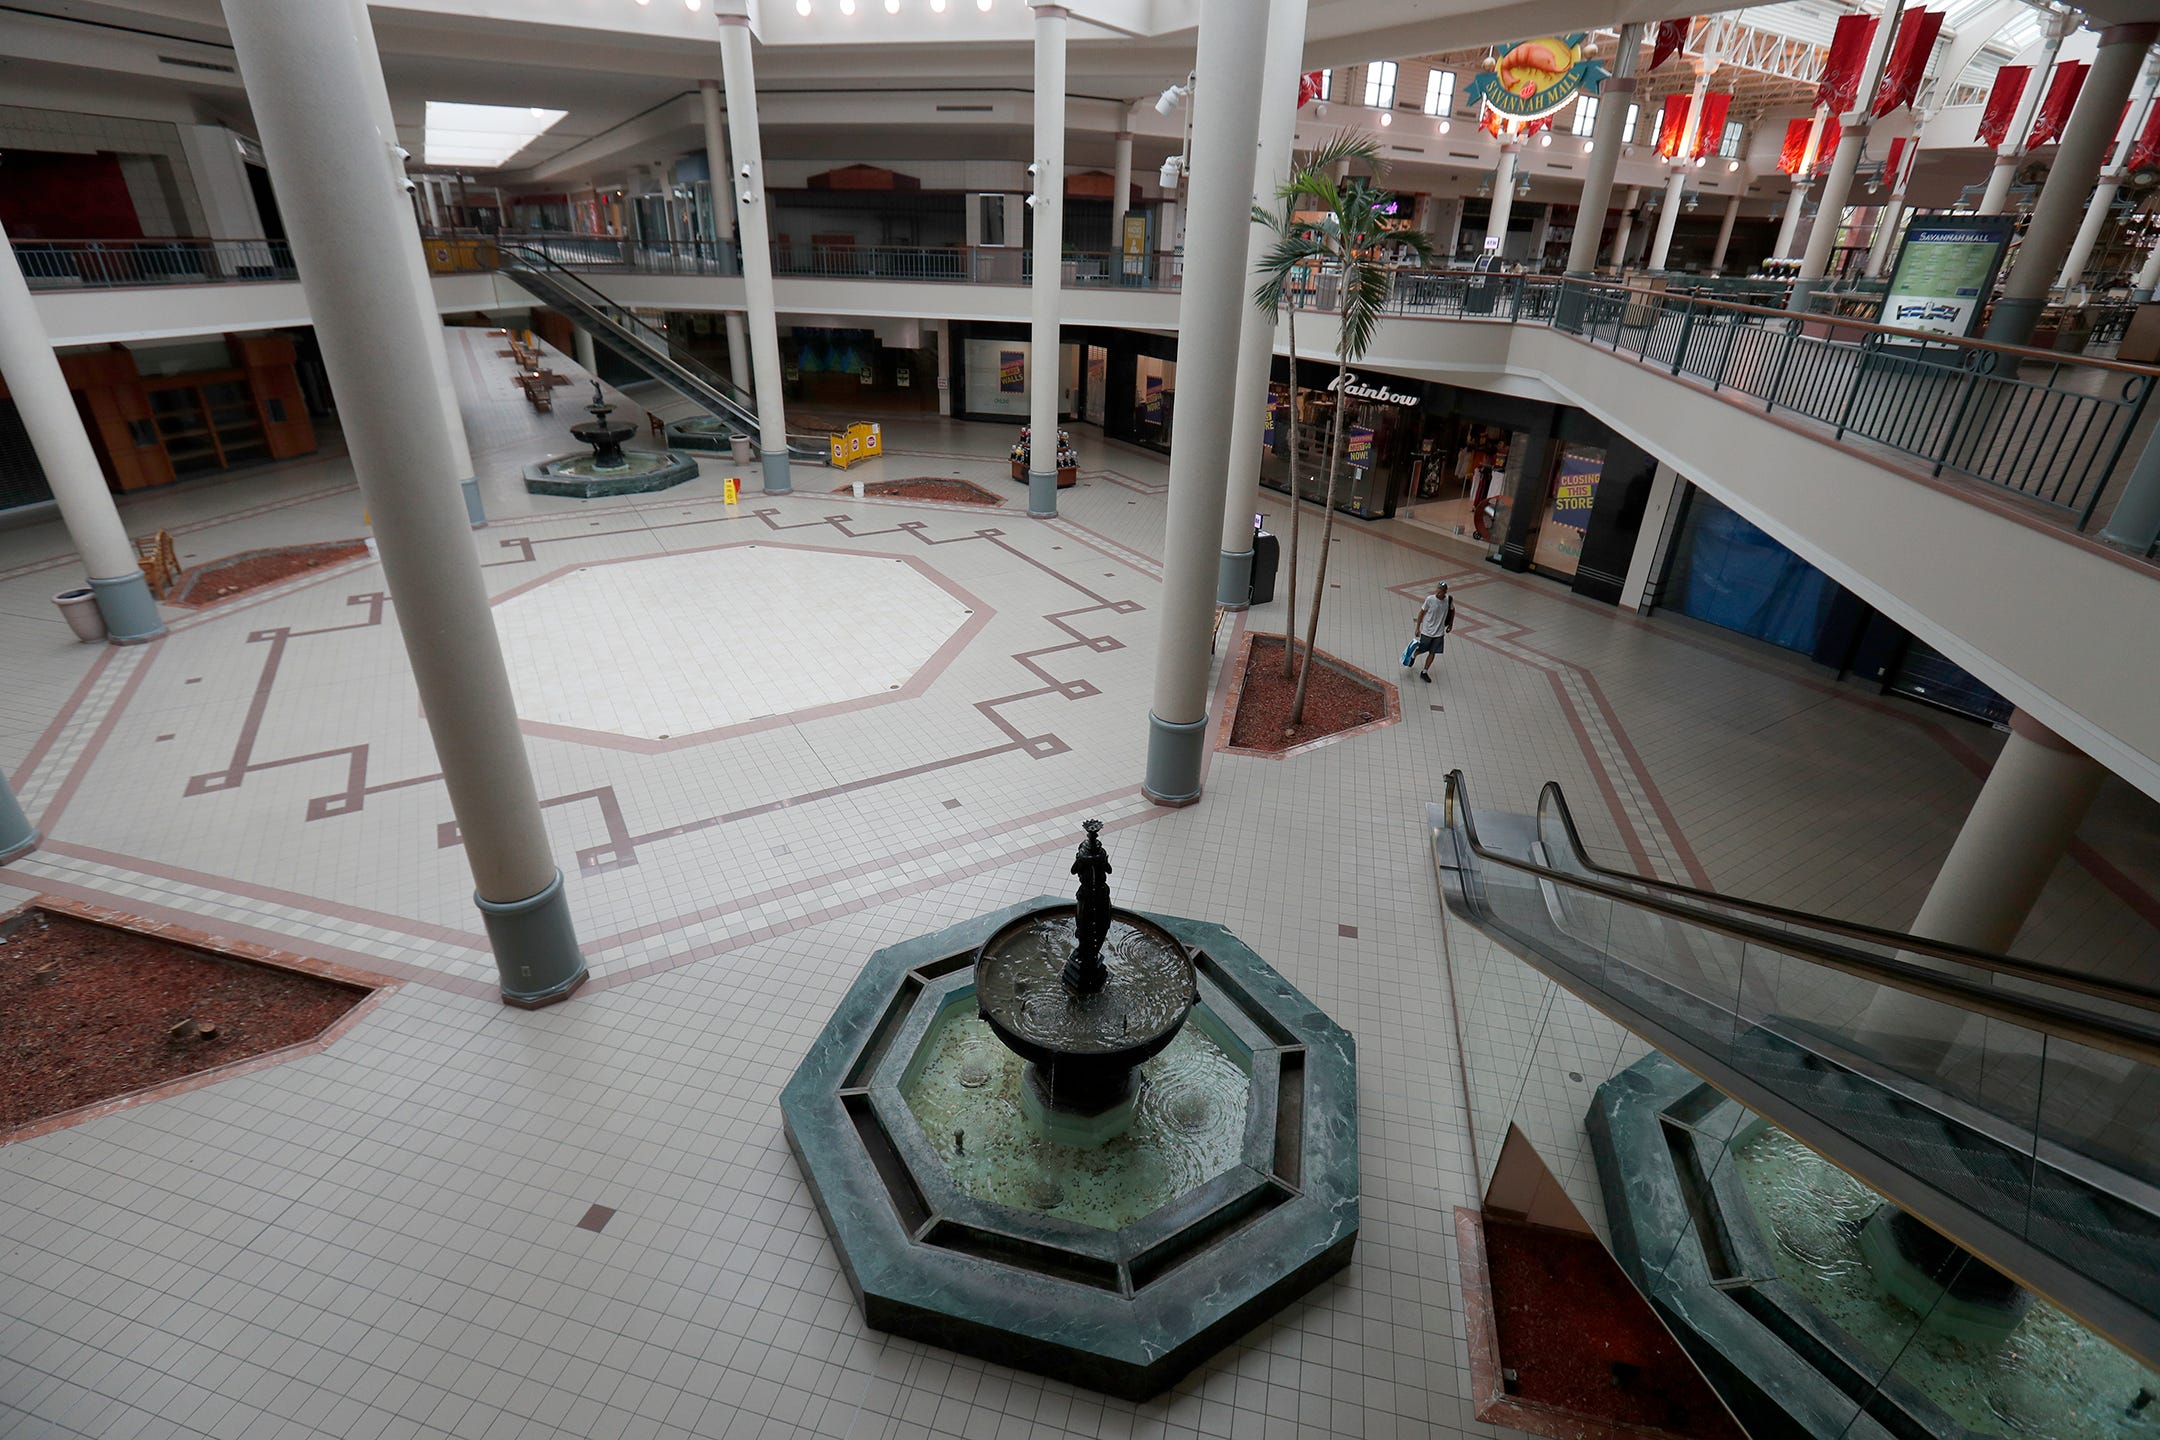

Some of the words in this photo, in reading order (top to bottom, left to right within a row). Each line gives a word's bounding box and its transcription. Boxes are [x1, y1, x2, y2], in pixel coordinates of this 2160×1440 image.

[1486, 80, 1544, 112] SAVANNAH
[1548, 72, 1580, 104] MALL
[1327, 373, 1418, 406] Rainbow
[1350, 451, 1369, 461] NOW!
[1561, 473, 1601, 486] CLOSING
[1568, 486, 1588, 496] THIS
[1556, 497, 1594, 510] STORE
